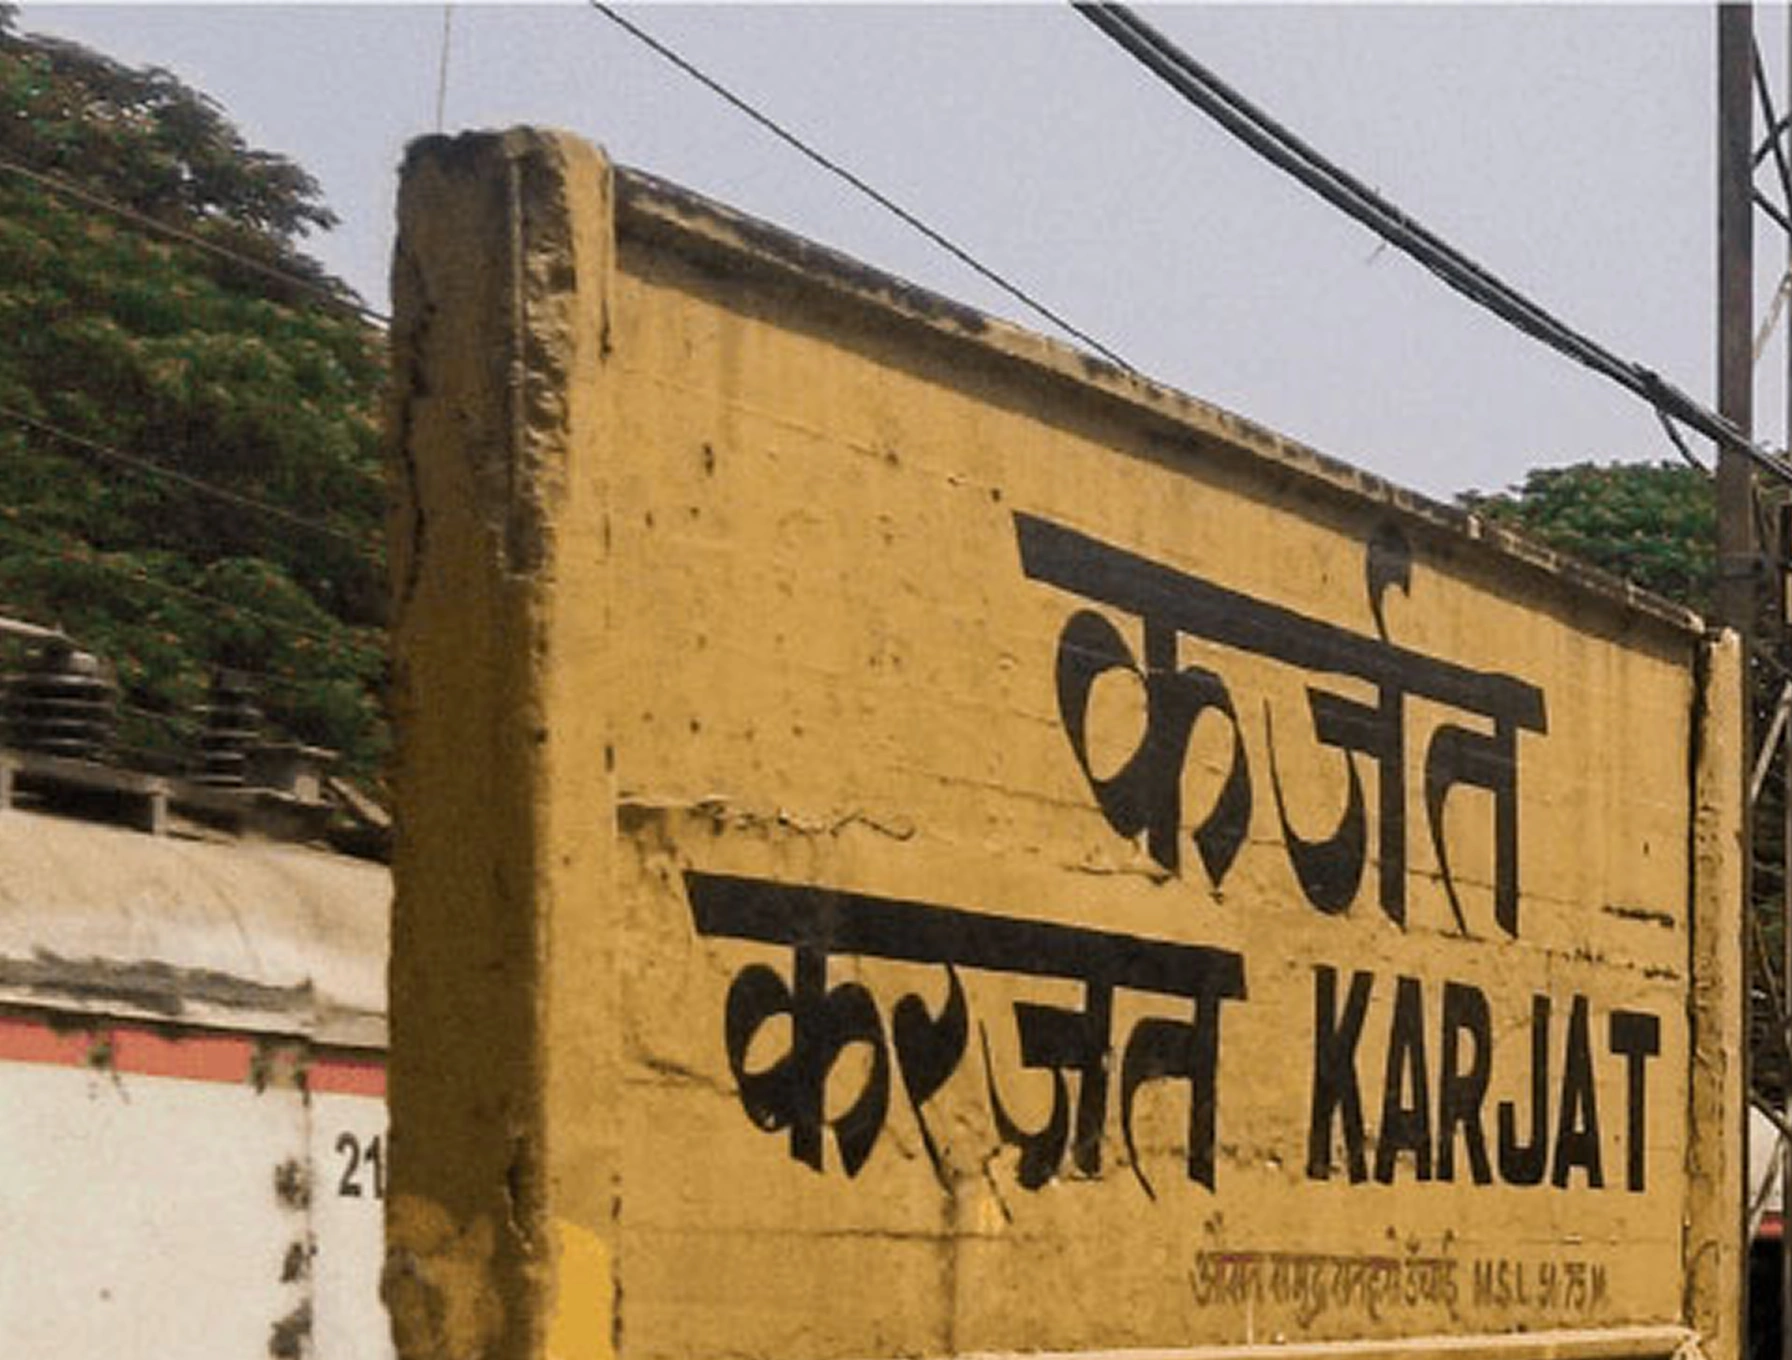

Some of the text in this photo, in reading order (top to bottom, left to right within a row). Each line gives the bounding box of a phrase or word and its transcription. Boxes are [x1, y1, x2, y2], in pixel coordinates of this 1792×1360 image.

[1012, 510, 1548, 940] कर्जत
[334, 1130, 385, 1200] 21
[683, 869, 1247, 1203] करजत
[1305, 963, 1661, 1191] KARJAT
